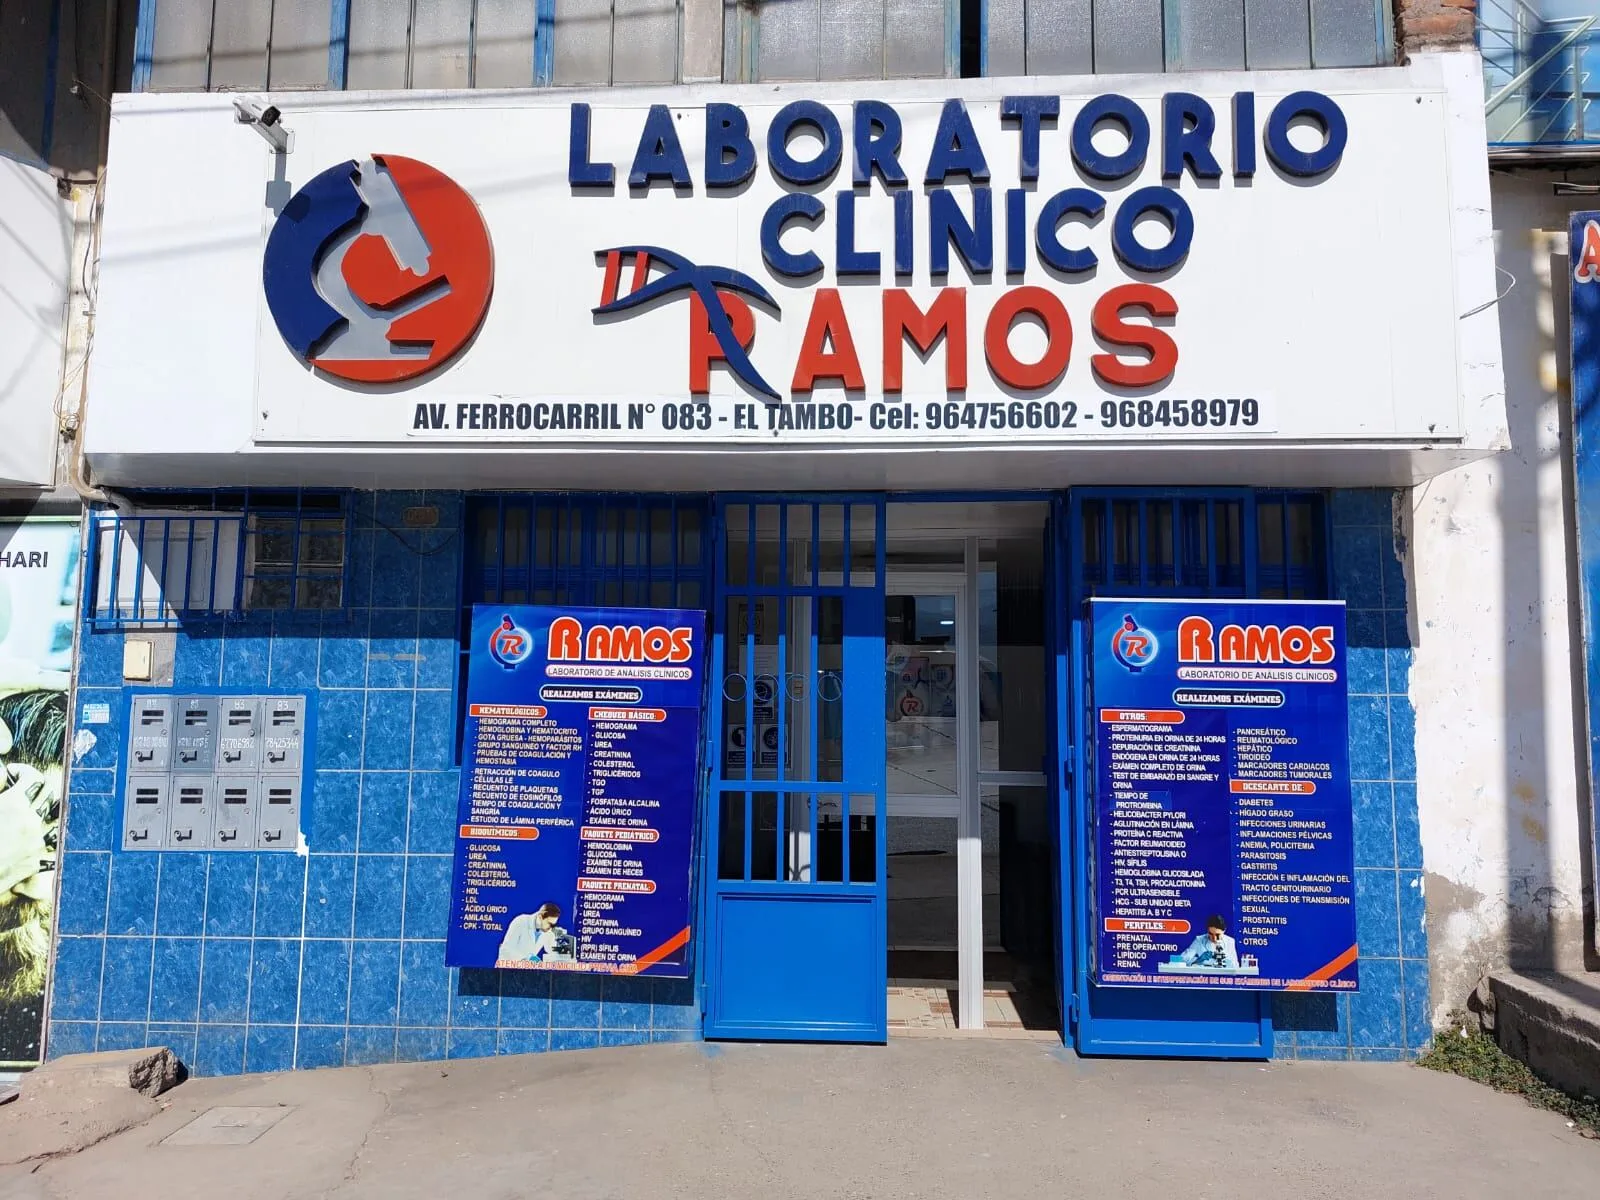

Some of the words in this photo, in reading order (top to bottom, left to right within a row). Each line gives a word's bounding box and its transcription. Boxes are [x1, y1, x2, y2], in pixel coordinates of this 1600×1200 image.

[569, 90, 1348, 190] LABORATORIO
[760, 186, 1195, 279] CLINICO
[689, 283, 1180, 396] RAMOS
[413, 405, 449, 429] AV.
[457, 404, 625, 429] FERROCARRIL
[628, 404, 655, 429] N°
[662, 404, 712, 429] 083
[734, 404, 758, 429] EL
[869, 403, 919, 429] Cel:
[926, 403, 1077, 429] 964756602
[1101, 400, 1259, 427] 968458979
[548, 667, 604, 677] LABORATORIO
[605, 669, 616, 677] DE
[616, 666, 652, 678] ANÁLISIS
[654, 668, 690, 679] CLÍNICOS
[1180, 670, 1240, 680] LABORATORIO
[1241, 671, 1254, 680] DE
[1255, 669, 1293, 681] ANÁLISIS
[1295, 670, 1335, 681] CLÍNICOS
[543, 689, 594, 699] REALIZAMOS
[595, 689, 639, 700] EXÁMENES
[1177, 693, 1232, 703] REALIZAMOS
[1233, 693, 1281, 704] EXÁMENES
[1237, 726, 1286, 736] PANCREÁTICO
[1237, 736, 1298, 745] REUMATOLÓGICO
[1237, 744, 1272, 752] HEPÁTICO
[1238, 762, 1287, 770] MARCADORES
[474, 768, 516, 776] RETRACCIÓN
[1238, 770, 1287, 778] MARCADORES
[1289, 771, 1332, 779] TUMORALES
[590, 807, 610, 815] ÁCIDO
[1239, 809, 1267, 817] HÍGADO
[589, 817, 616, 825] EXÁMEN
[1240, 820, 1287, 828] INFECCIONES
[1288, 821, 1326, 829] URINARIAS
[584, 830, 614, 838] PAQUETE
[1240, 831, 1297, 839] INFLAMACIONES
[1298, 831, 1333, 839] PÉLVICAS
[470, 844, 501, 852] GLUCOSA
[1271, 842, 1315, 850] POLICITEMIA
[1241, 852, 1286, 860] PARASITOSIS
[586, 858, 612, 867] EXÁMEN
[623, 860, 642, 868] ORINA
[468, 870, 510, 878] COLESTEROL
[586, 866, 612, 874] EXÁMEN
[1242, 873, 1279, 881] INFECCIÓN
[1287, 874, 1335, 882] INFLAMACIÓN
[467, 878, 516, 887] TRIGLICÉRIDOS
[582, 880, 612, 889] PAQUETE
[465, 896, 478, 904] LDL
[584, 894, 625, 902] HEMOGRAMA
[1242, 895, 1289, 903] INFECCIONES
[1302, 896, 1350, 904] TRANSMISIÓN
[465, 904, 485, 913] ÁCIDO
[584, 902, 614, 910] GLUCOSA
[583, 910, 600, 918] UREA
[463, 922, 477, 930] CPK
[582, 927, 604, 935] GRUPO
[1117, 934, 1152, 942] PRENATAL
[1133, 944, 1178, 952] OPERATORIO
[580, 952, 606, 960] EXÁMEN
